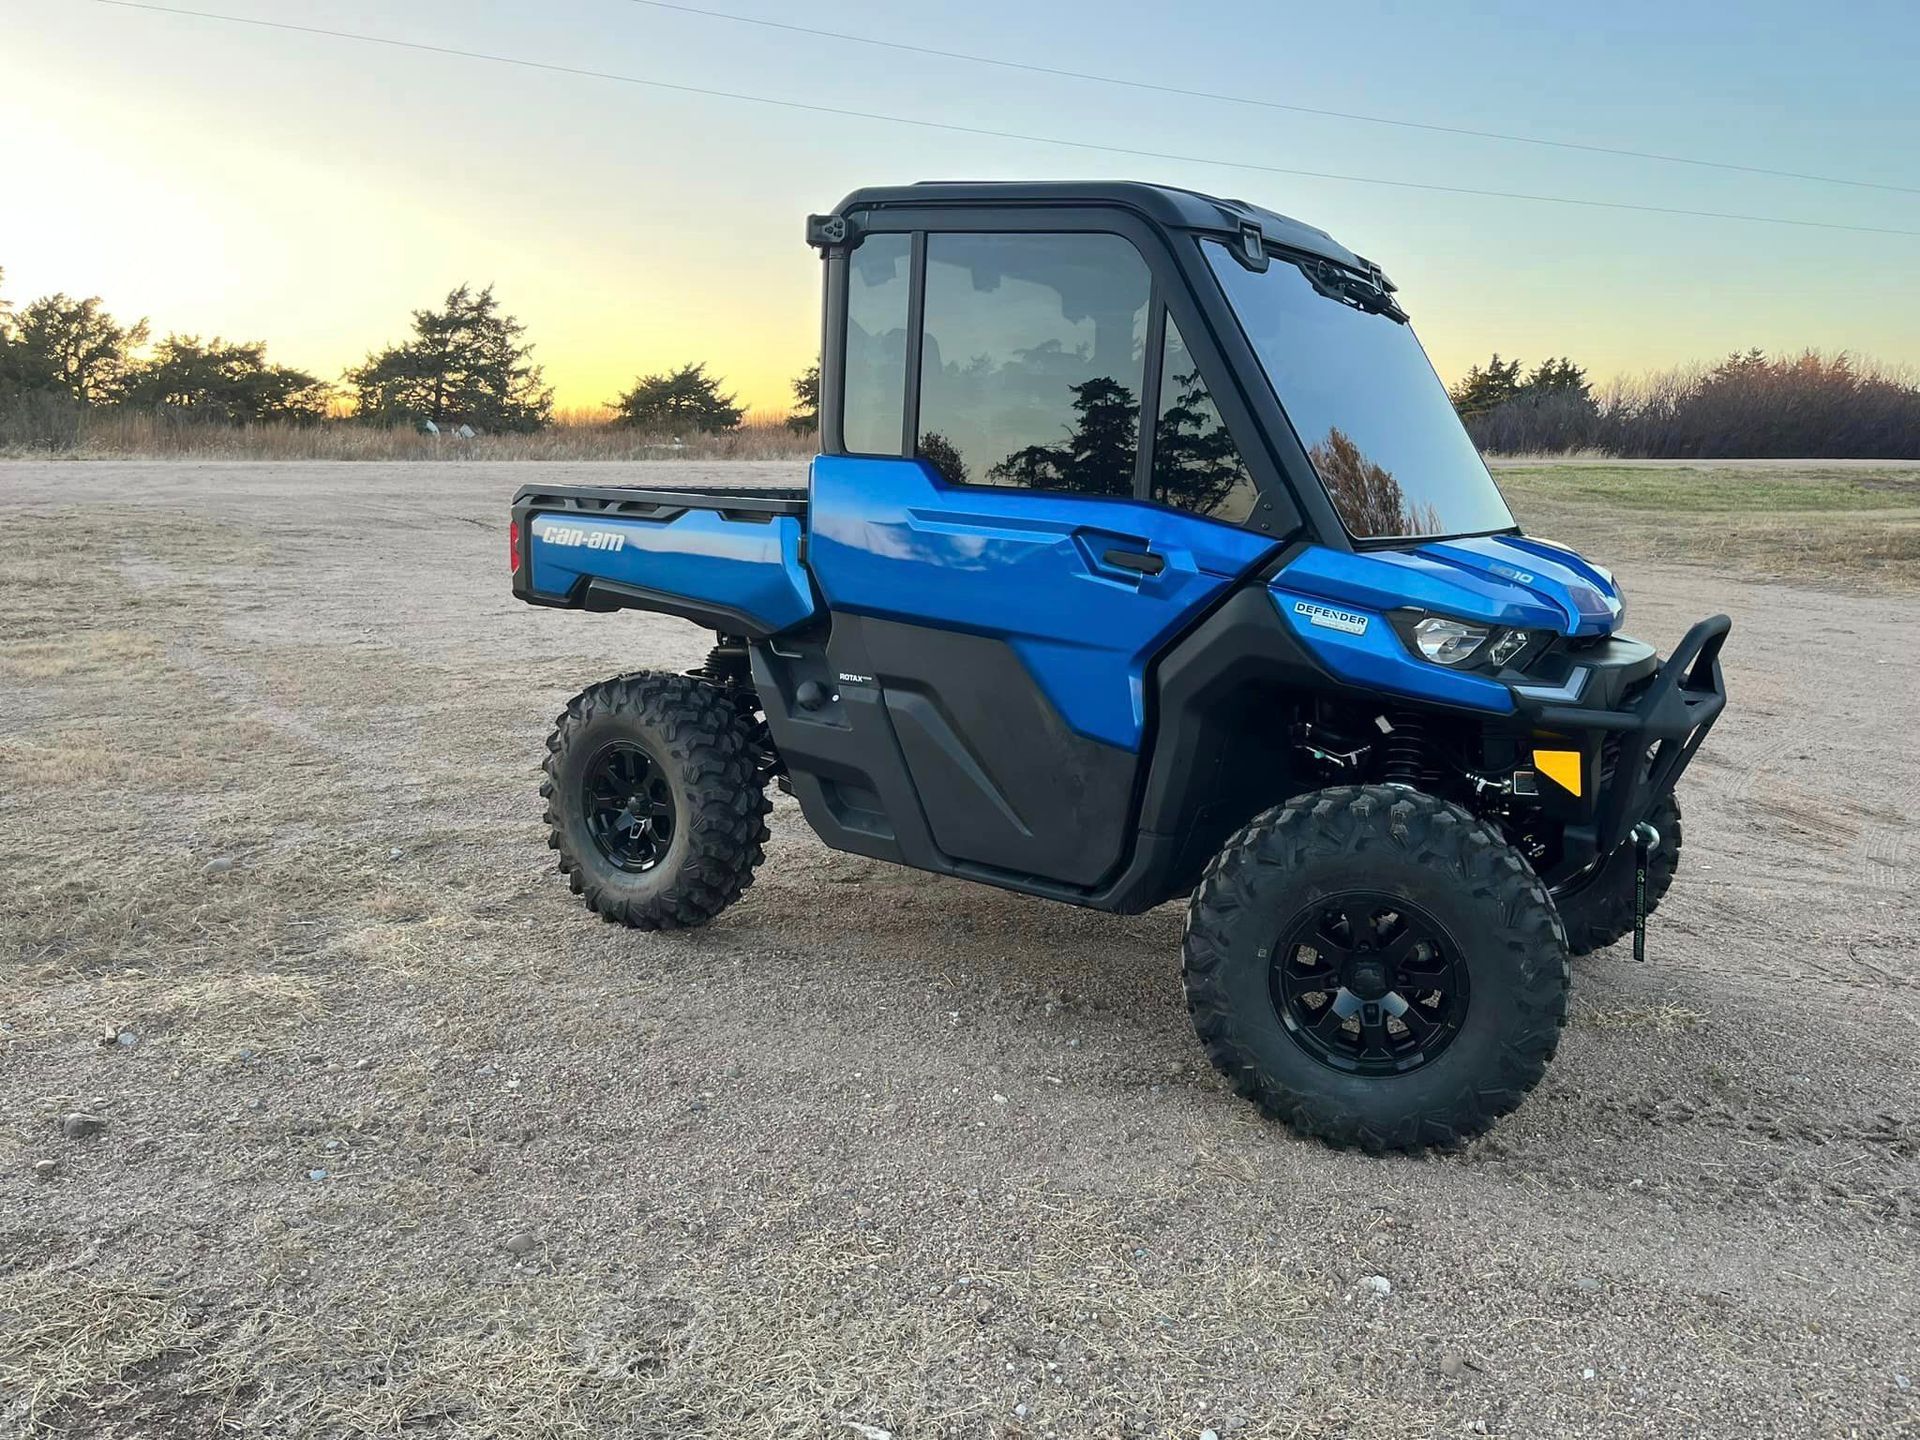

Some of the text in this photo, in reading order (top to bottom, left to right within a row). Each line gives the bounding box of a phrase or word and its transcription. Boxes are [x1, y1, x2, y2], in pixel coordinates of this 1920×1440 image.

[542, 527, 625, 552] can-am
[1296, 603, 1366, 626] DEFENDER
[840, 673, 863, 682] ROTAX
